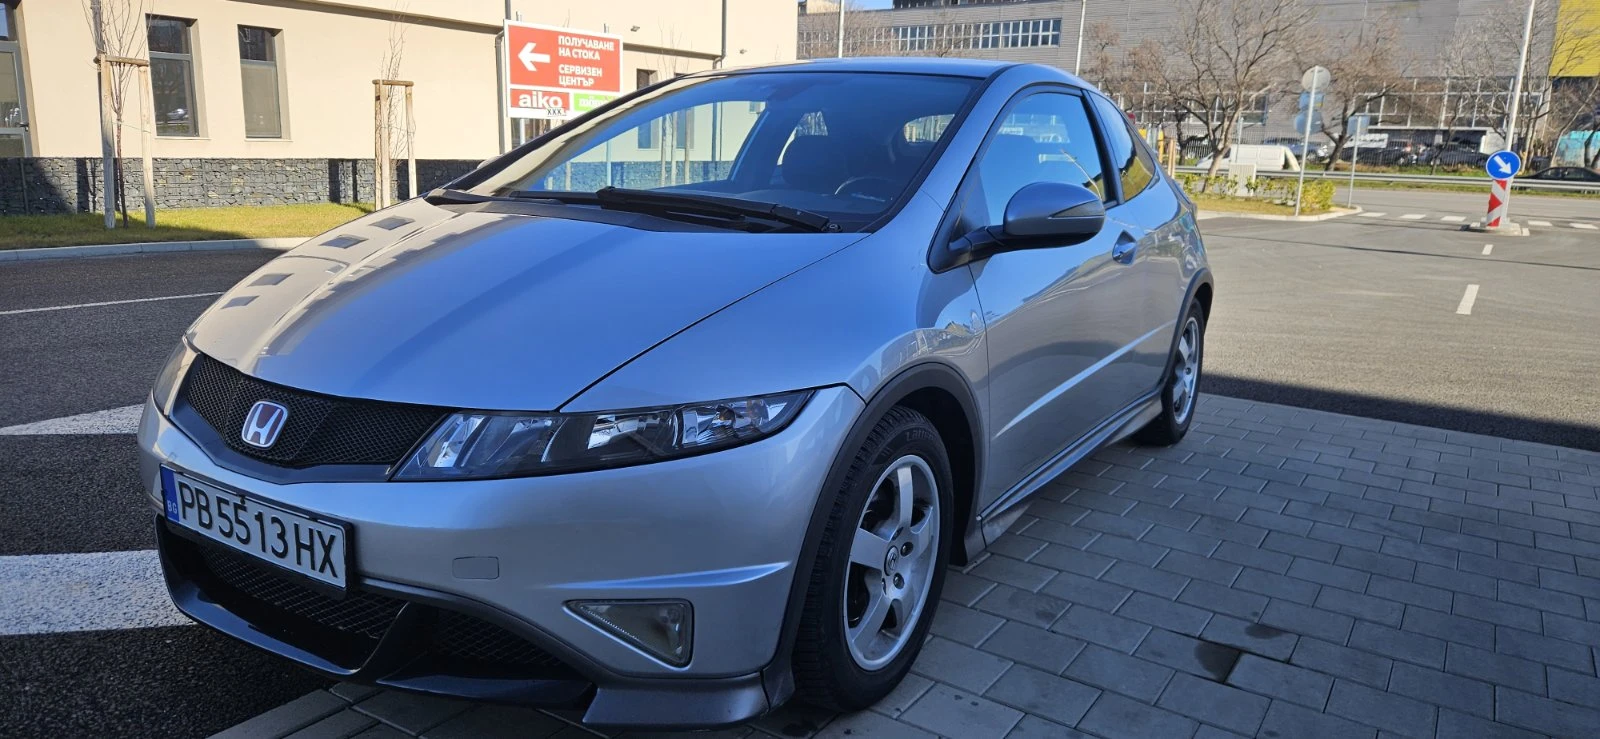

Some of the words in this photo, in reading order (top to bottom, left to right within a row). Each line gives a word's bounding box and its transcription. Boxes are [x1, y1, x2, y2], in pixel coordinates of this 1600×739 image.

[558, 35, 614, 51] ПОЛУЧАВАНЕ
[558, 47, 571, 58] НА
[572, 48, 600, 60] СТОКА
[558, 64, 603, 77] СЕРВИЗЕН
[558, 75, 595, 87] ЦЕНТЪР
[518, 91, 563, 109] aiko
[167, 501, 178, 514] BG
[216, 495, 288, 559] 5513
